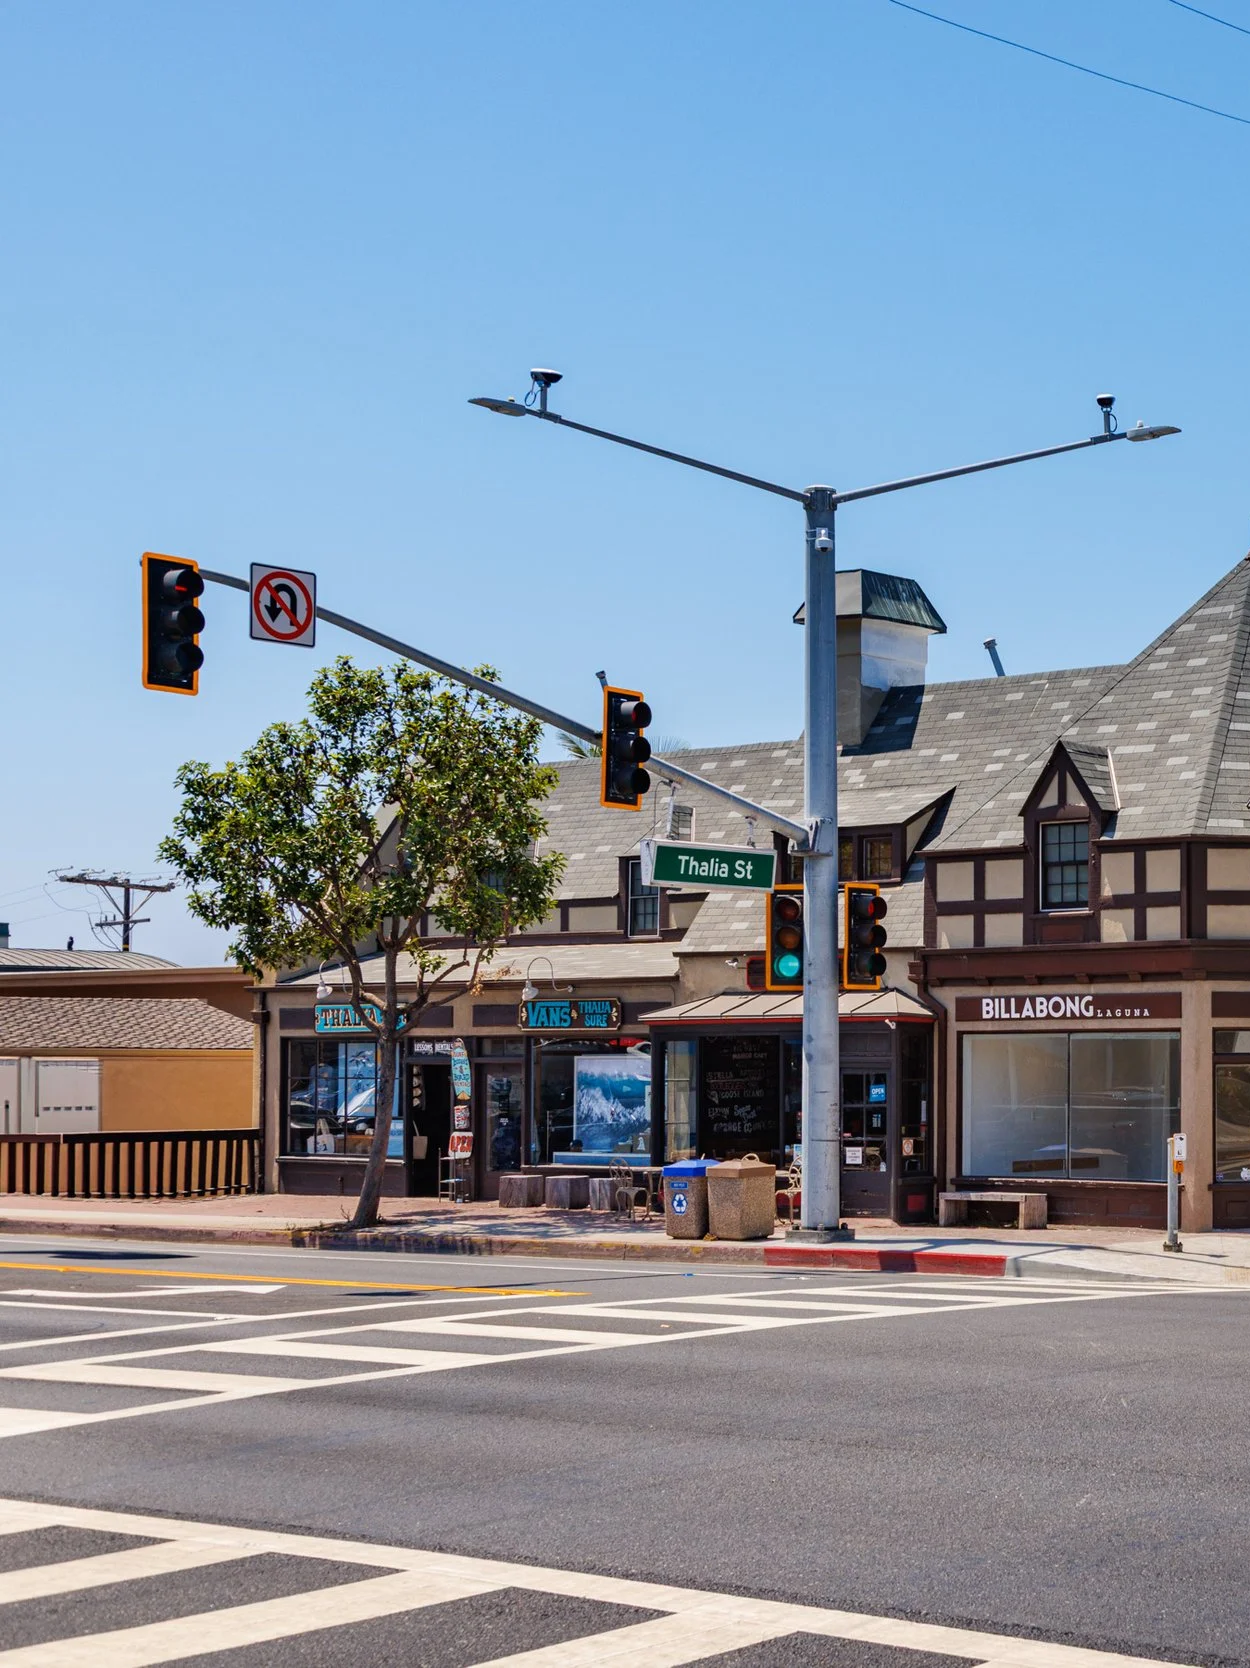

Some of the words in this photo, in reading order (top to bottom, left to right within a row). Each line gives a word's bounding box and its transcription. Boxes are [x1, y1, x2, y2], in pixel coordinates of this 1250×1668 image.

[678, 855, 729, 878] Thalia
[734, 859, 753, 880] St
[527, 1000, 572, 1027] VANS
[578, 1001, 611, 1013] THALIA
[982, 996, 1094, 1019] BILLABONG
[1096, 1008, 1150, 1017] LAGUNA
[321, 1008, 379, 1028] THALA
[584, 1014, 609, 1027] SURF
[414, 1043, 433, 1051] LESSONS
[871, 1087, 885, 1095] OPEN
